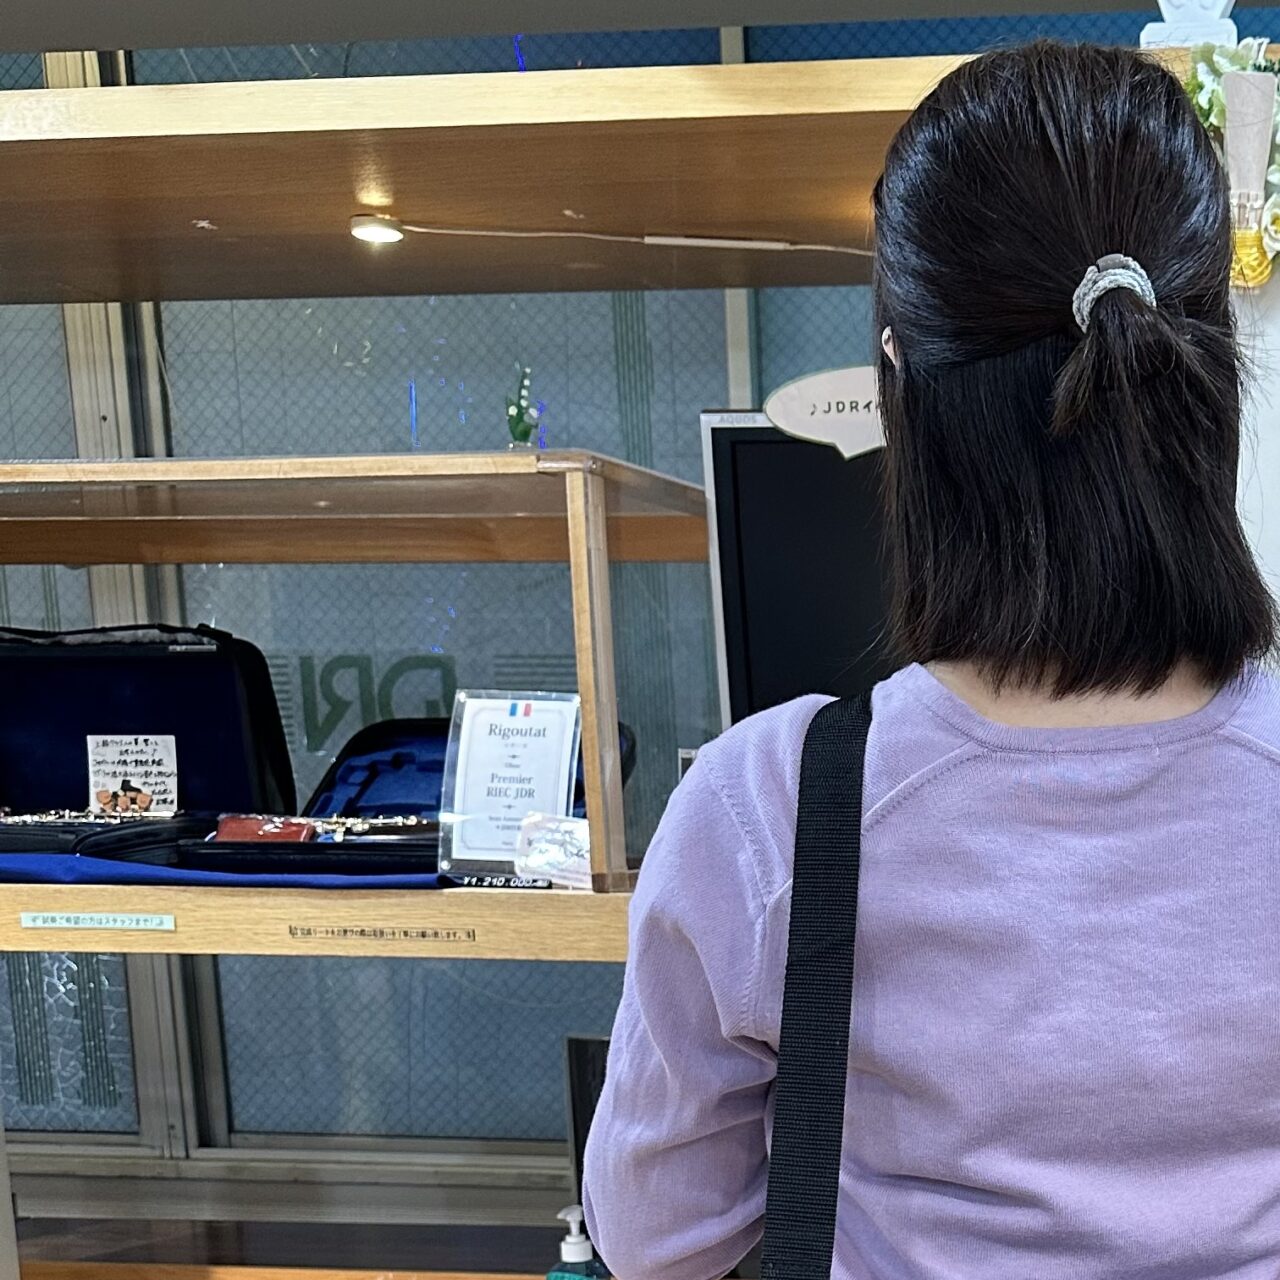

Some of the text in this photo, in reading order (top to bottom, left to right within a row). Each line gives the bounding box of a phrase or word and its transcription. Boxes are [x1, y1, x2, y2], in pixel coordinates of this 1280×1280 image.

[719, 415, 758, 424] AQUOS
[488, 723, 549, 739] Rigoutat
[490, 773, 534, 785] Premier
[486, 786, 536, 800] RIEC JDR
